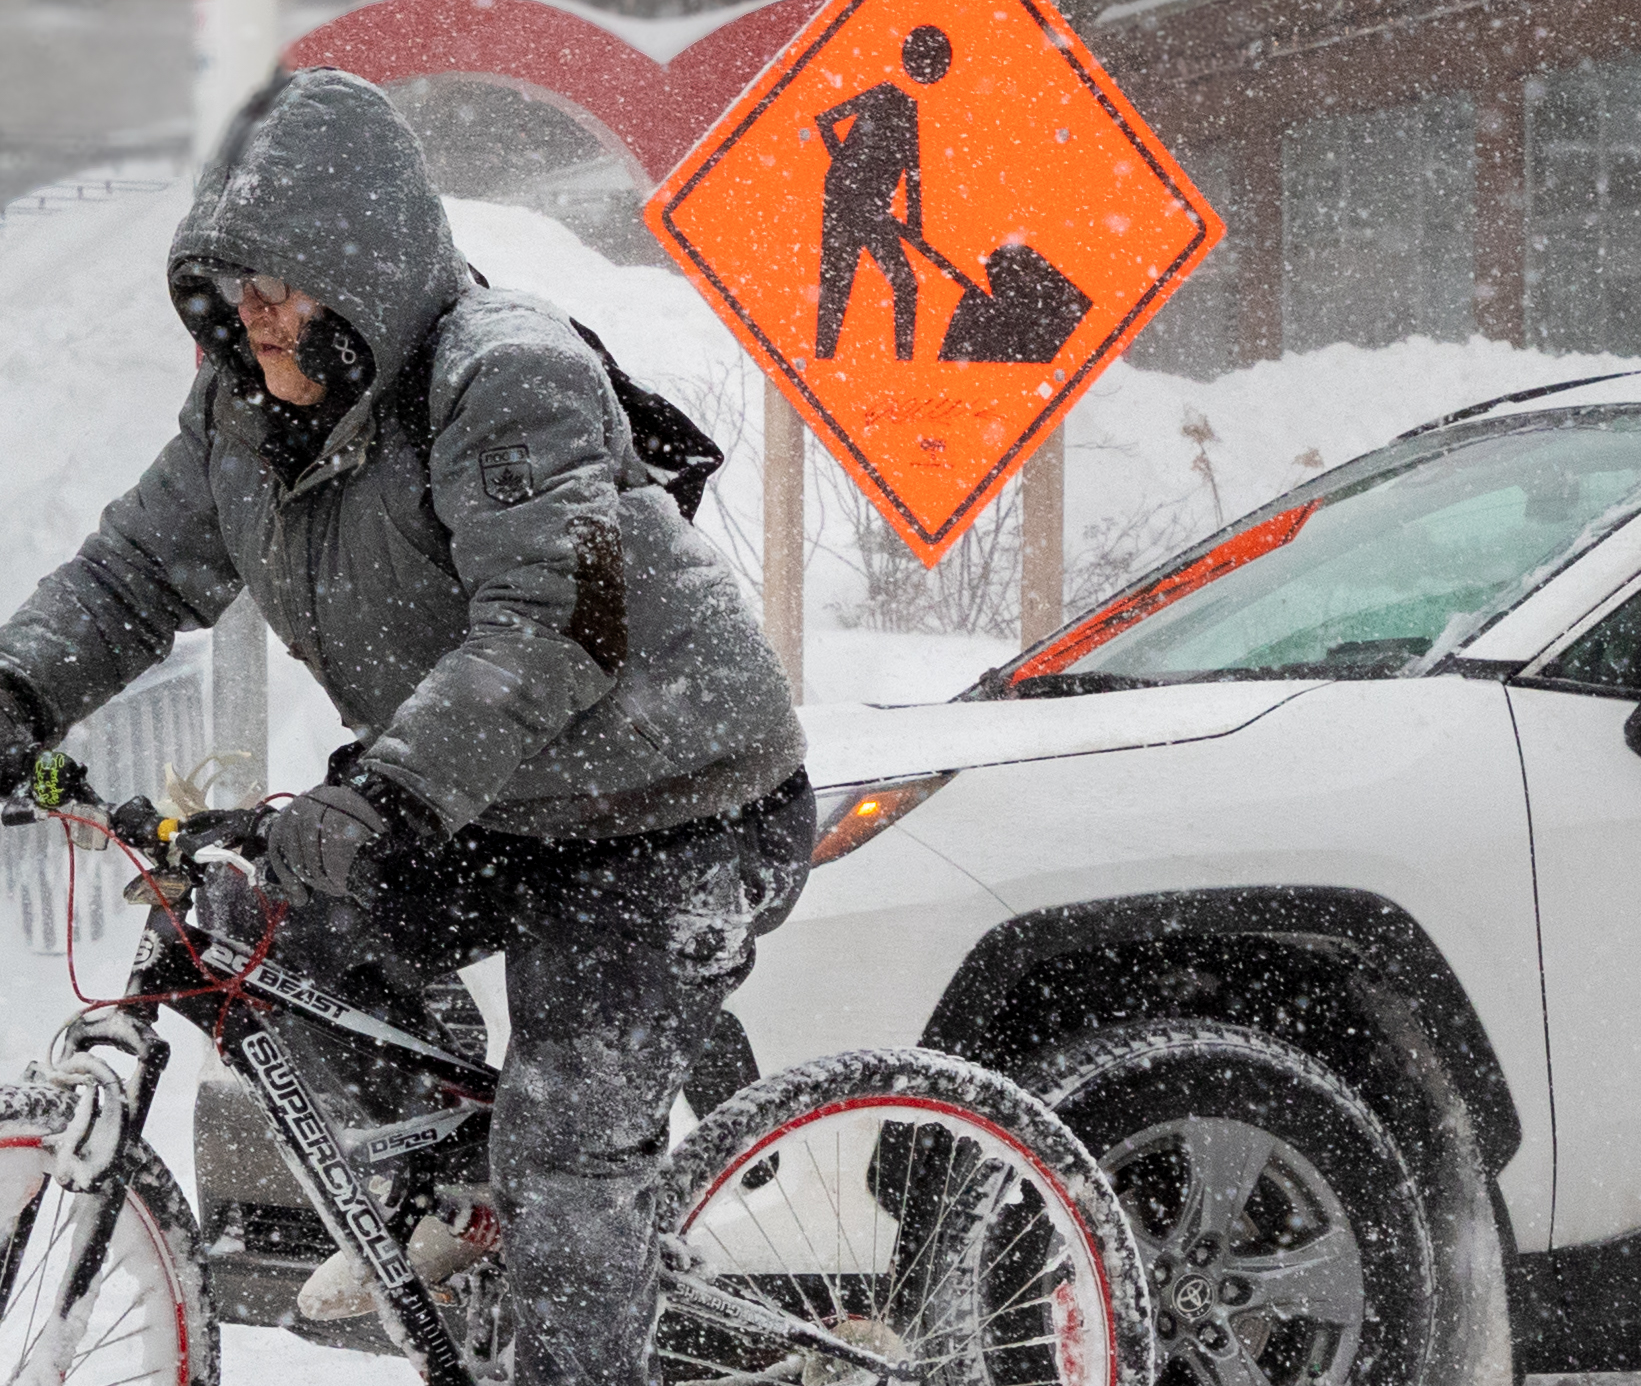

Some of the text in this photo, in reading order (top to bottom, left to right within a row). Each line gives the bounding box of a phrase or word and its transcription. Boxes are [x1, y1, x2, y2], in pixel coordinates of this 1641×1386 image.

[257, 969, 350, 1019] BEAST
[244, 1033, 412, 1286] SUPERCYCLE
[371, 1128, 438, 1154] DS29
